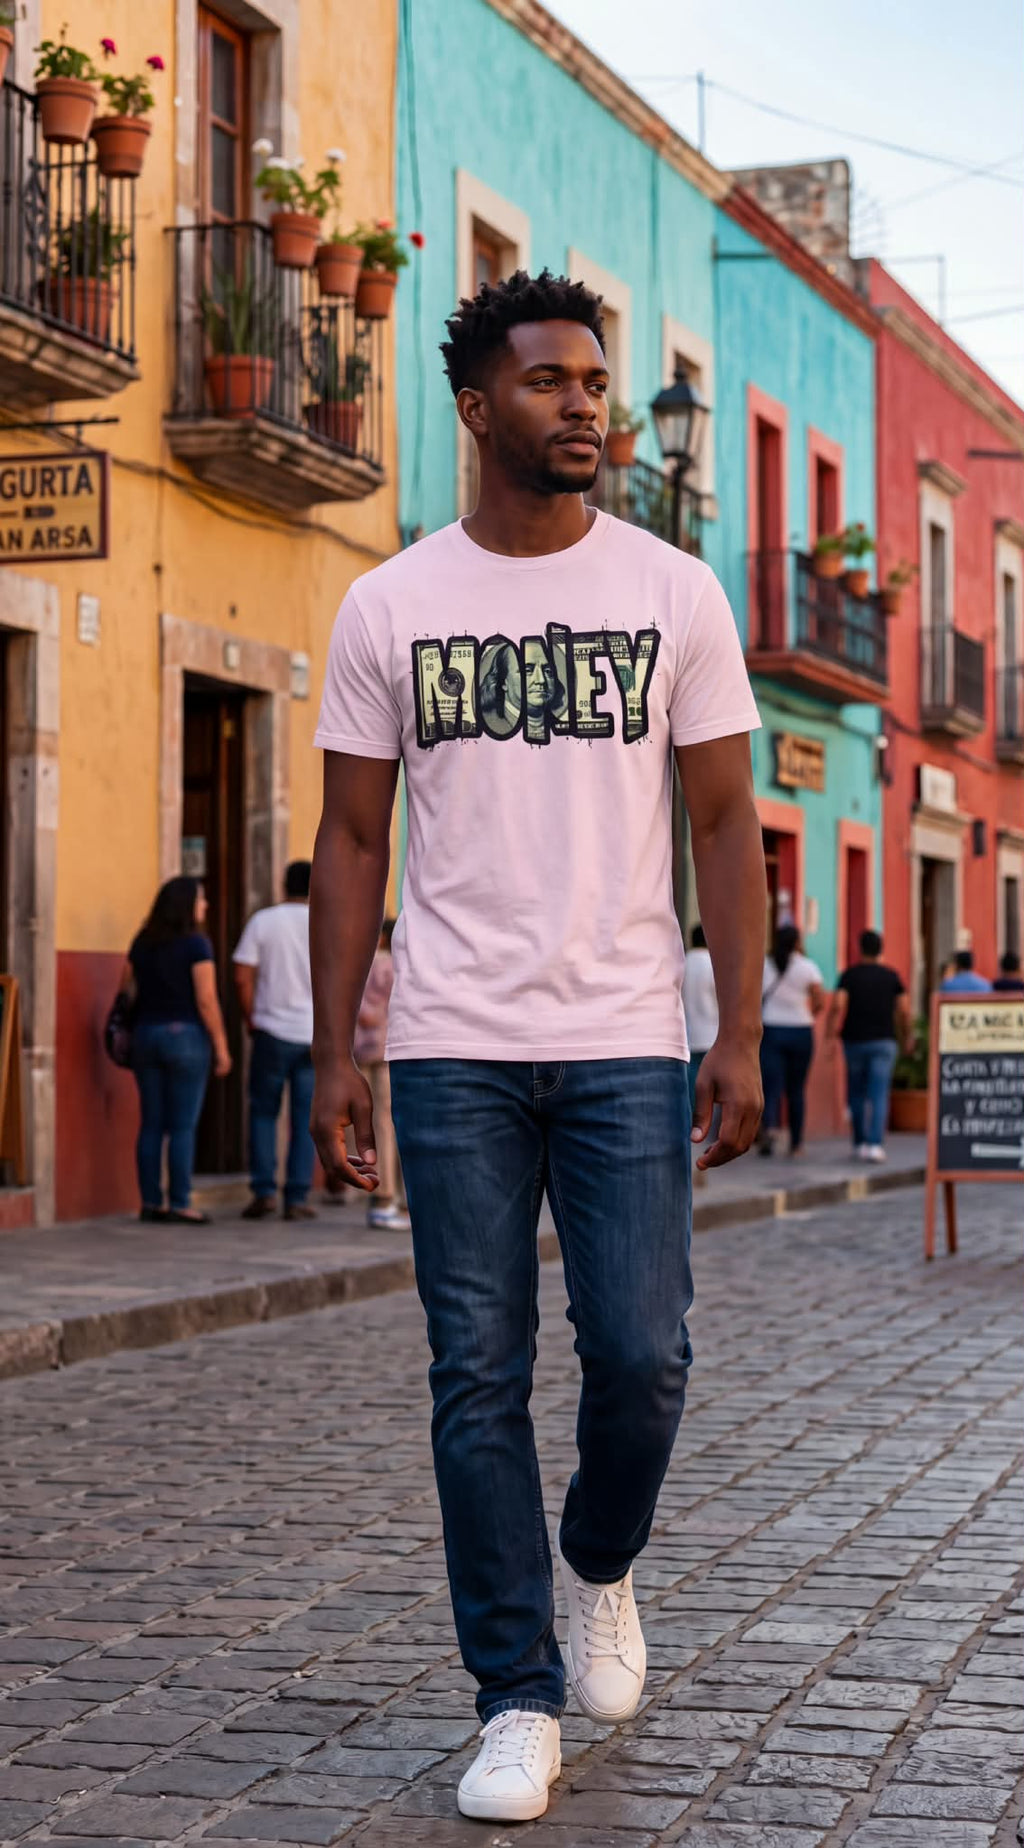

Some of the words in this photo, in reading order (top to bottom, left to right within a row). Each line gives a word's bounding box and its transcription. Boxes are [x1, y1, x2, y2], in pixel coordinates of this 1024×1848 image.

[0, 463, 94, 500] GURTA
[30, 525, 92, 549] ARSA
[411, 622, 661, 748] MONEY
